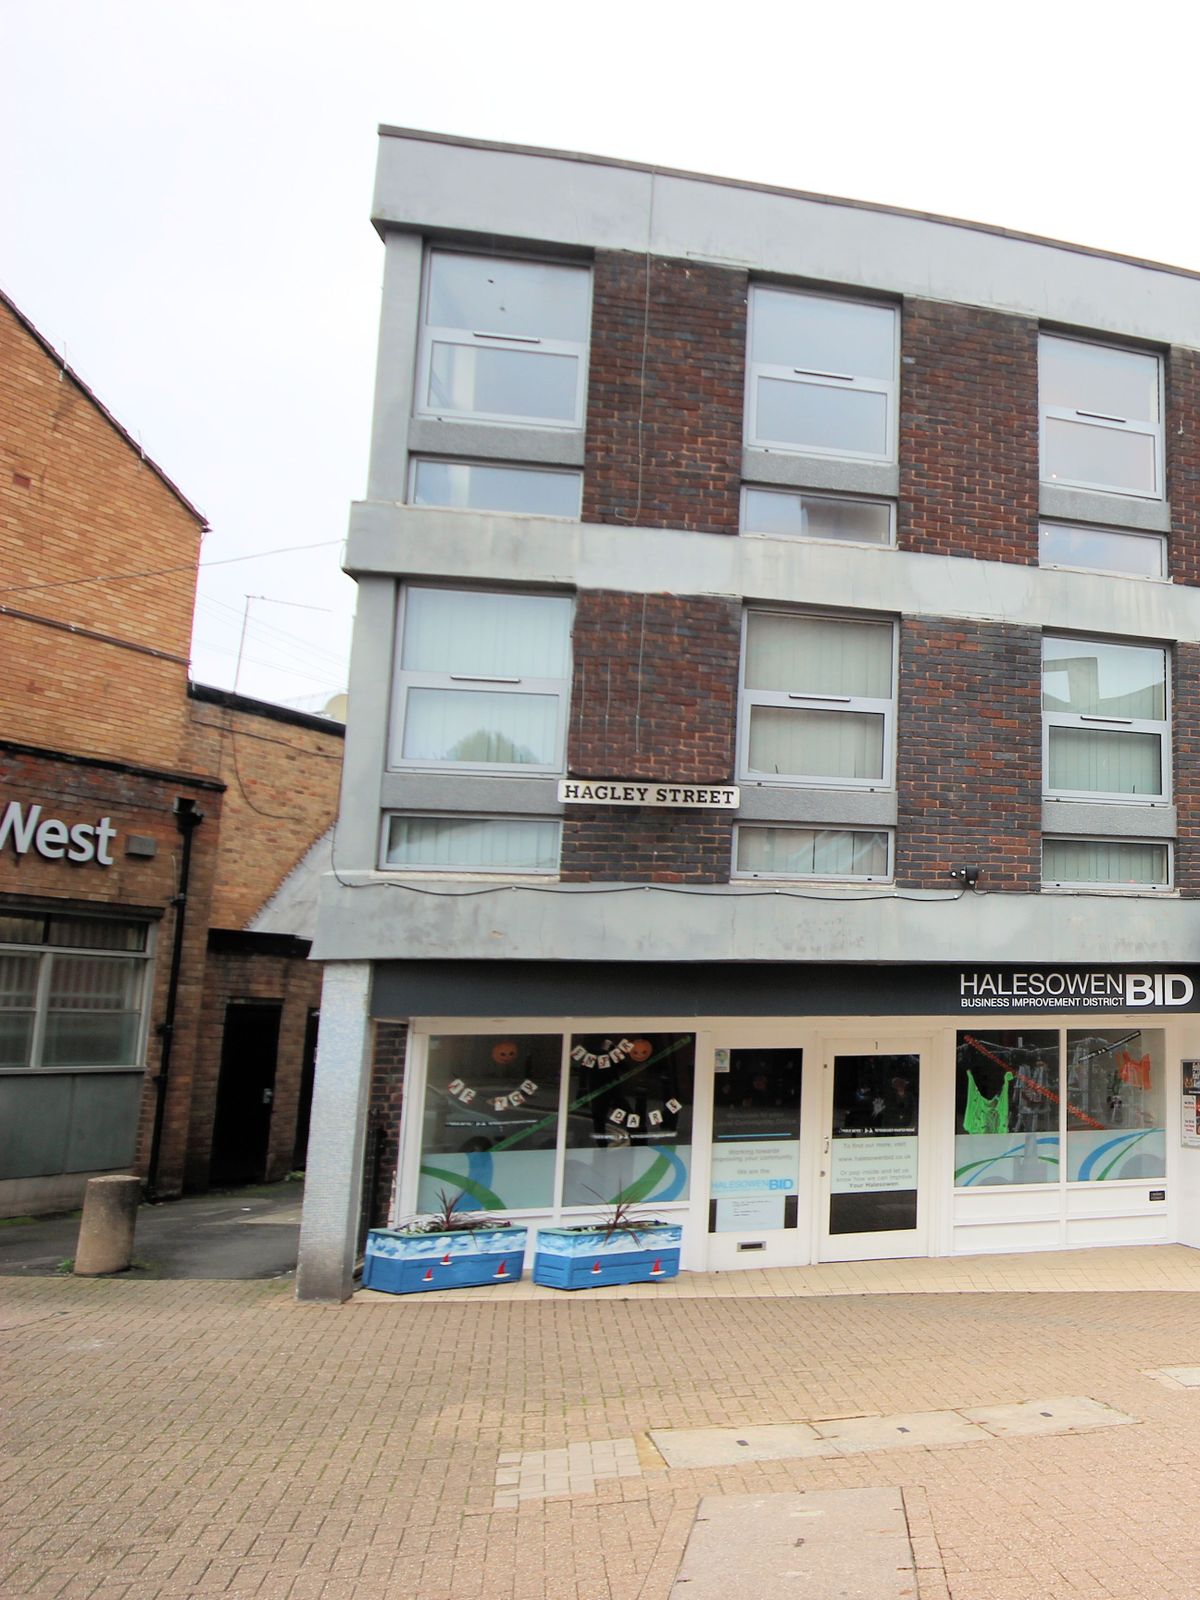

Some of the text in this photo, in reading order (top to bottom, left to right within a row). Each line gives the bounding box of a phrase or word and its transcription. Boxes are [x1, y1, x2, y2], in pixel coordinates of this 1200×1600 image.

[565, 784, 734, 804] HAGLEY STREET
[959, 973, 1194, 1006] HALESOWEN BID
[961, 997, 1123, 1008] BUSINESS IMPROVEMENT DISTRICT
[768, 1178, 794, 1190] BID
